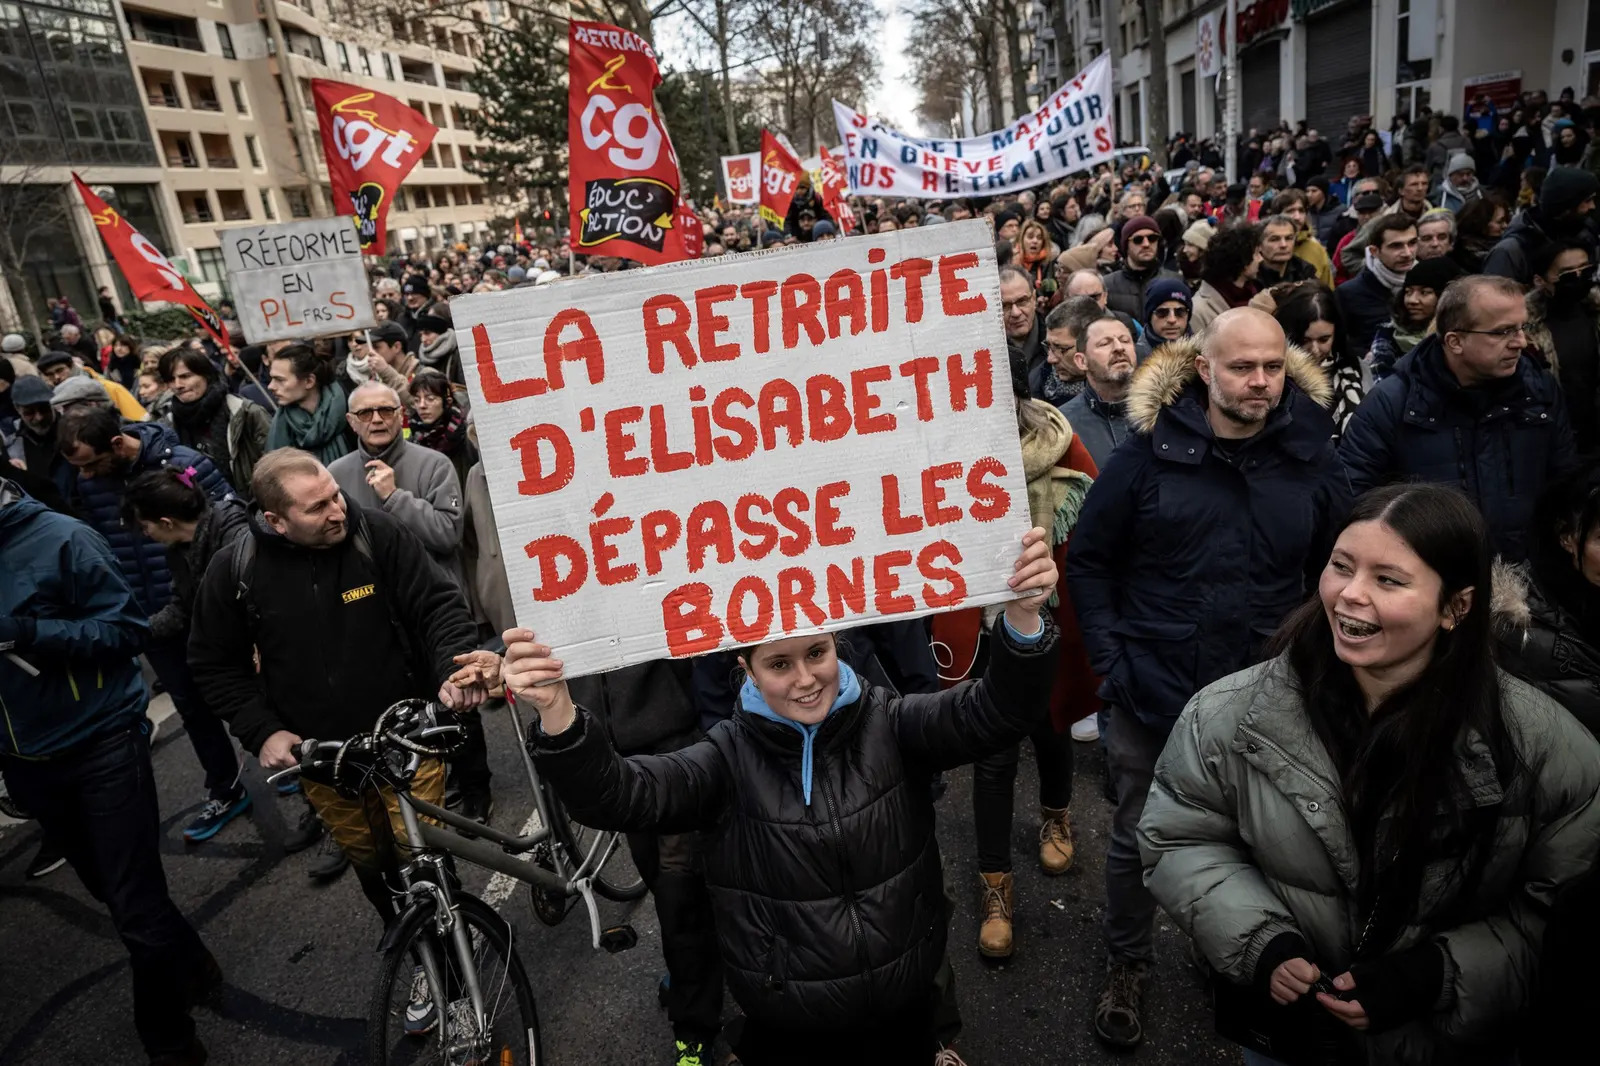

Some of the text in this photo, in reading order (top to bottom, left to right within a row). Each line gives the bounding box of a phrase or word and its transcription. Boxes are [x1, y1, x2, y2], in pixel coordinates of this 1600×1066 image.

[333, 115, 414, 171] cgt
[581, 94, 662, 171] cg
[845, 132, 878, 159] EN
[1028, 94, 1103, 151] POUR
[763, 164, 796, 195] cgt
[849, 164, 896, 190] NOS
[922, 127, 1110, 193] RETRAITES
[236, 229, 358, 268] RÉFORME
[282, 272, 313, 294] EN
[472, 309, 604, 404] LA
[530, 457, 1011, 602] DÉPASSE LES
[662, 540, 967, 657] BORNES
